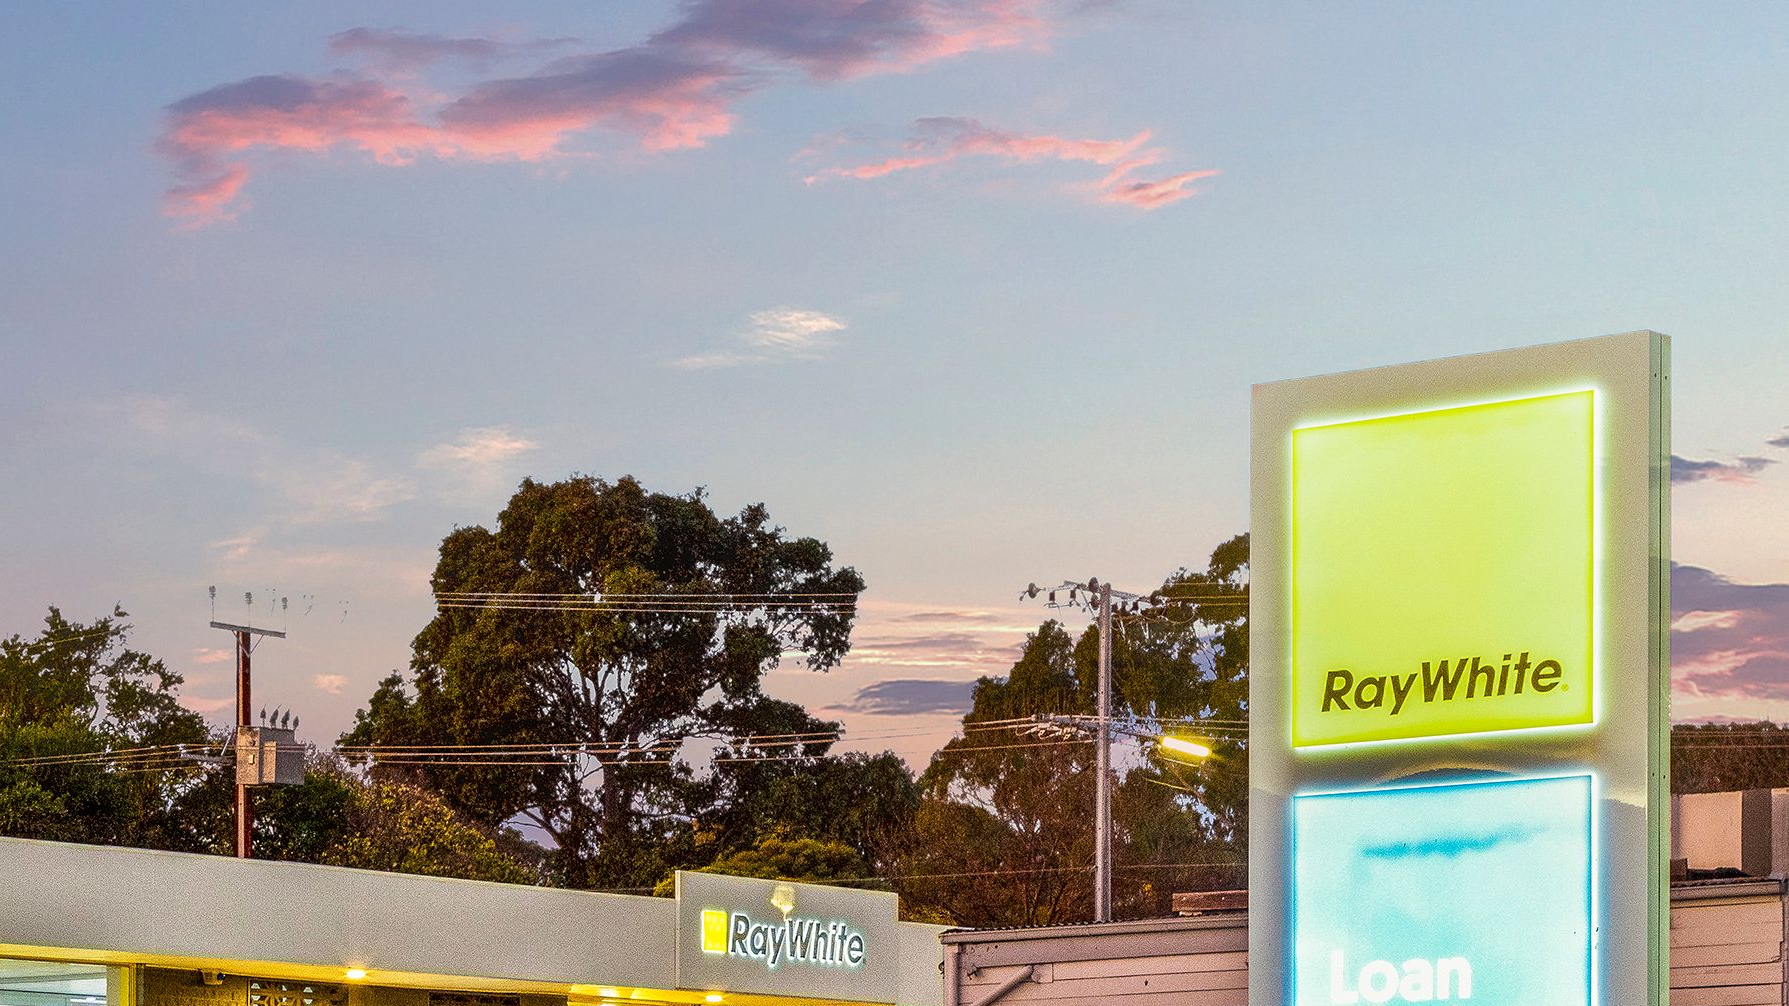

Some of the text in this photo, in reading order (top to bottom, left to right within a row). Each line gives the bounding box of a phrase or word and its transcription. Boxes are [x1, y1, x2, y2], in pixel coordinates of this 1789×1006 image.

[1321, 651, 1563, 716] RayWhite
[730, 914, 864, 965] RayWhite
[1330, 949, 1473, 1004] Loan
